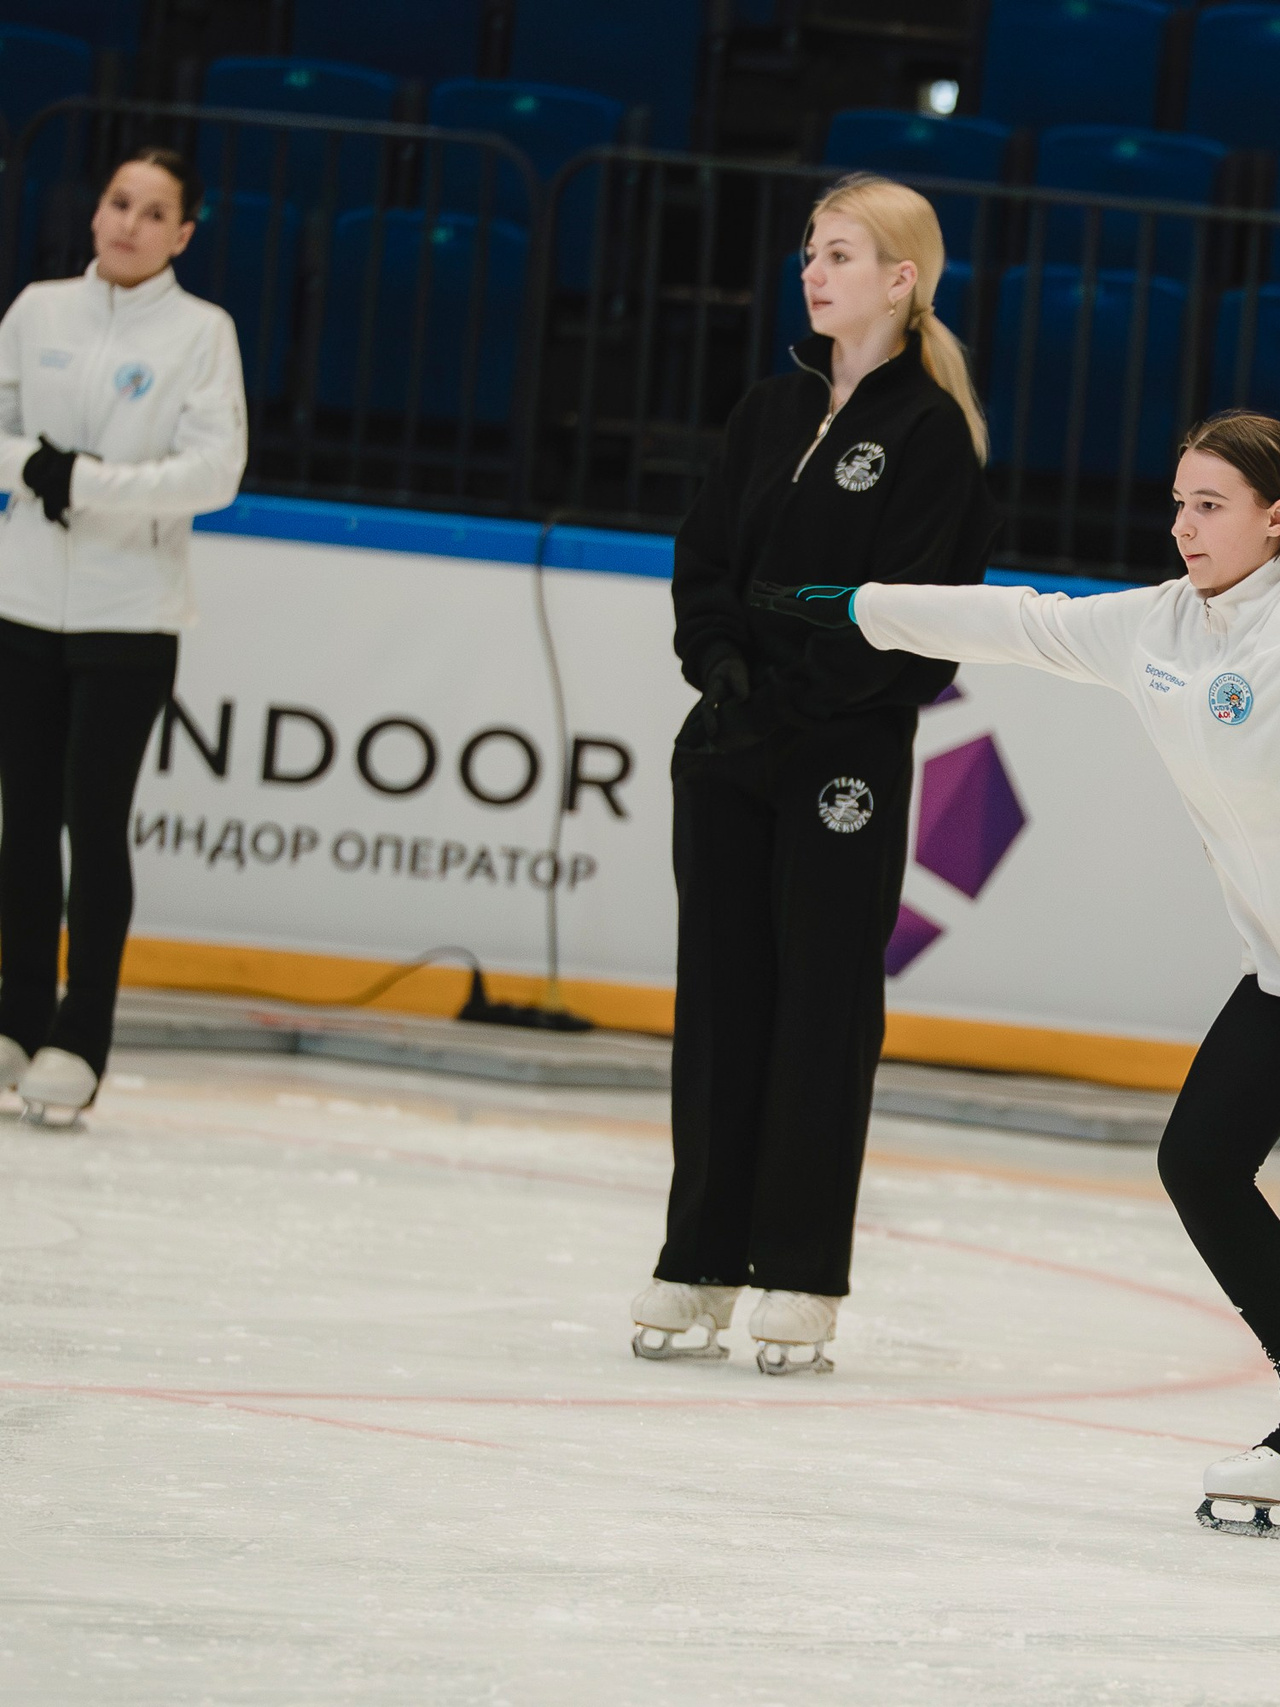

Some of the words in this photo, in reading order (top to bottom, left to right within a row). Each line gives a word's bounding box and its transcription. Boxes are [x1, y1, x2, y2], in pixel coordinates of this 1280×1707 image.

[1211, 675, 1249, 697] НОВОСИБИРСК
[134, 810, 321, 872] ИНДОР
[330, 830, 598, 890] ОПЕРАТОР
